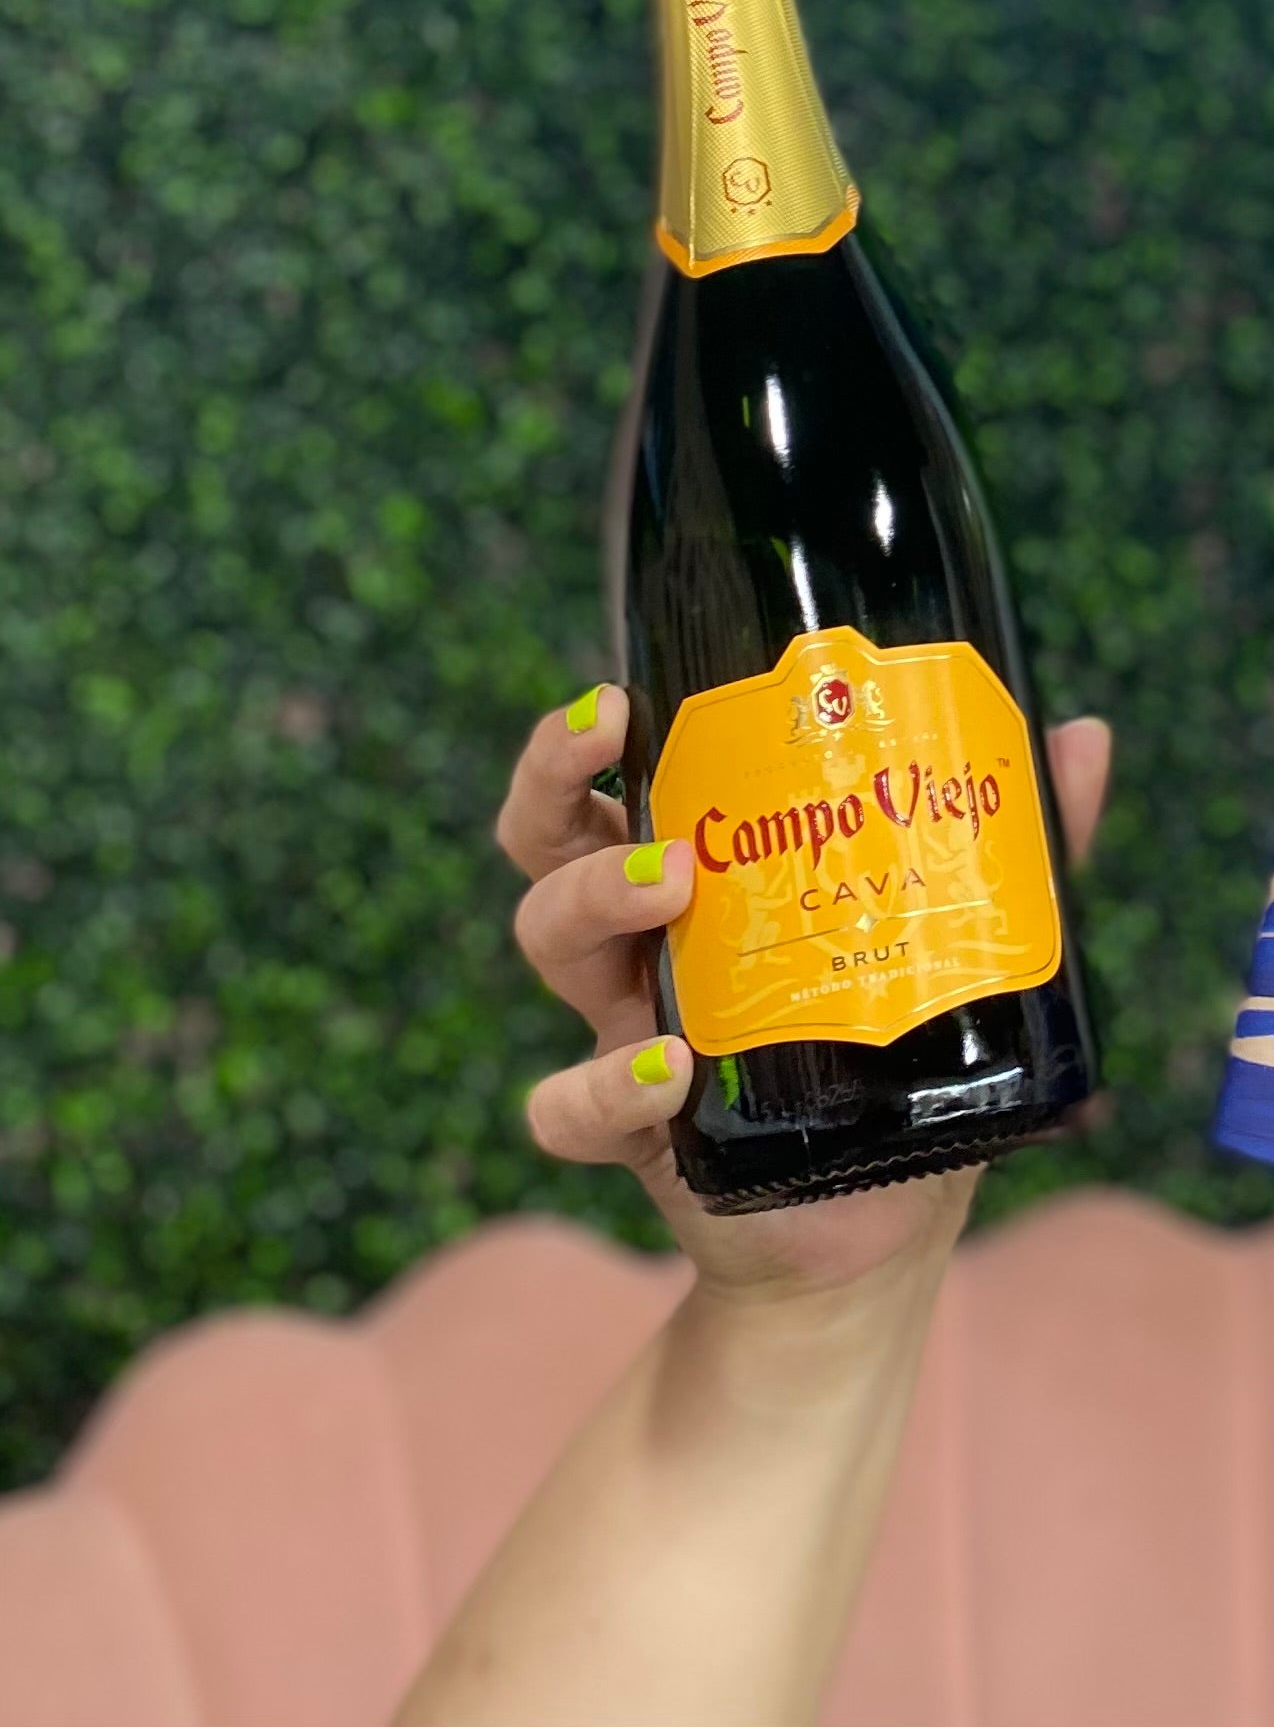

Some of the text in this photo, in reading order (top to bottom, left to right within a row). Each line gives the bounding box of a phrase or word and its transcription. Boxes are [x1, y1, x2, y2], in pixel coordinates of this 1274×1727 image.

[694, 793, 864, 873] Campo
[873, 759, 1001, 842] Viejo
[799, 866, 927, 912] CAVA
[832, 941, 910, 972] BRUT
